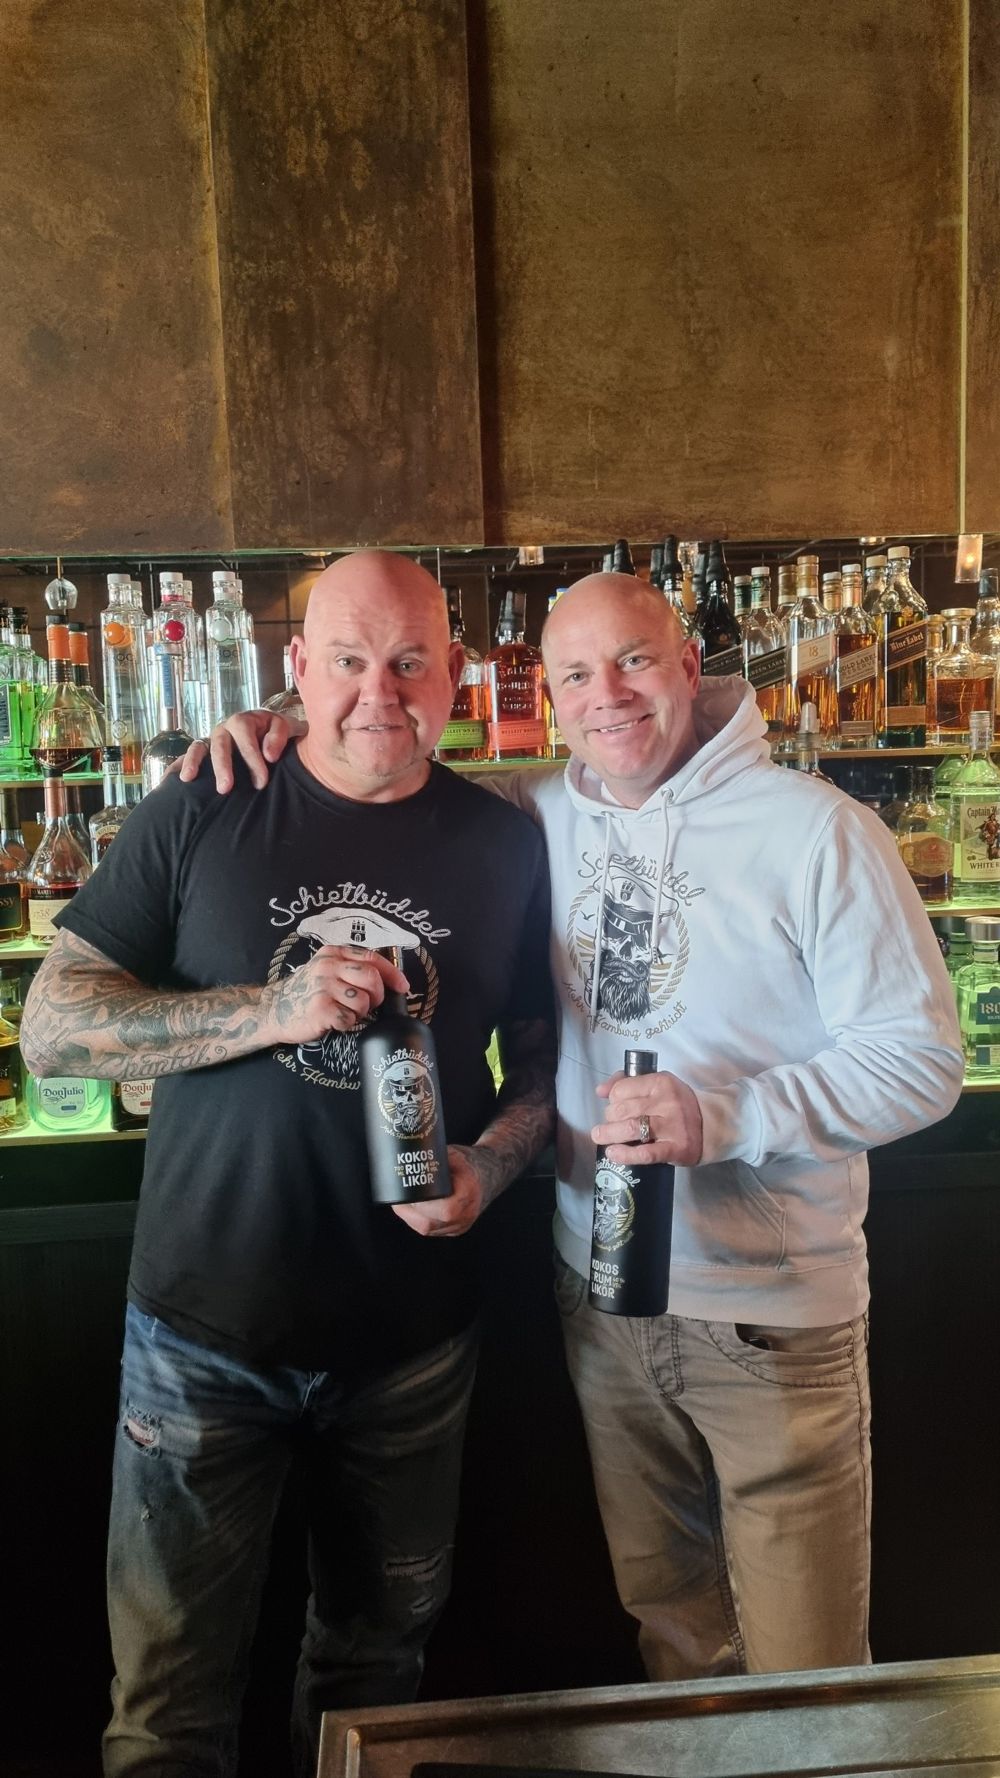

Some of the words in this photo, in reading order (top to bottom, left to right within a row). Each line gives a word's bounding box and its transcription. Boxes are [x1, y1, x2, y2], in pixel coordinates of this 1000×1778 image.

[890, 640, 906, 652] Blue
[905, 632, 924, 645] Label
[809, 645, 819, 657] 18
[967, 807, 991, 819] Captain
[969, 862, 994, 870] WHITE
[269, 882, 451, 945] Schietbüddel
[372, 1047, 434, 1078] Schietbüddel
[300, 1067, 361, 1091] Hambu
[396, 1149, 434, 1165] KOKOS
[405, 1161, 430, 1176] RUM
[402, 1171, 435, 1188] LIKÖR
[591, 1257, 620, 1276] KOKOS
[594, 1271, 612, 1287] RUM
